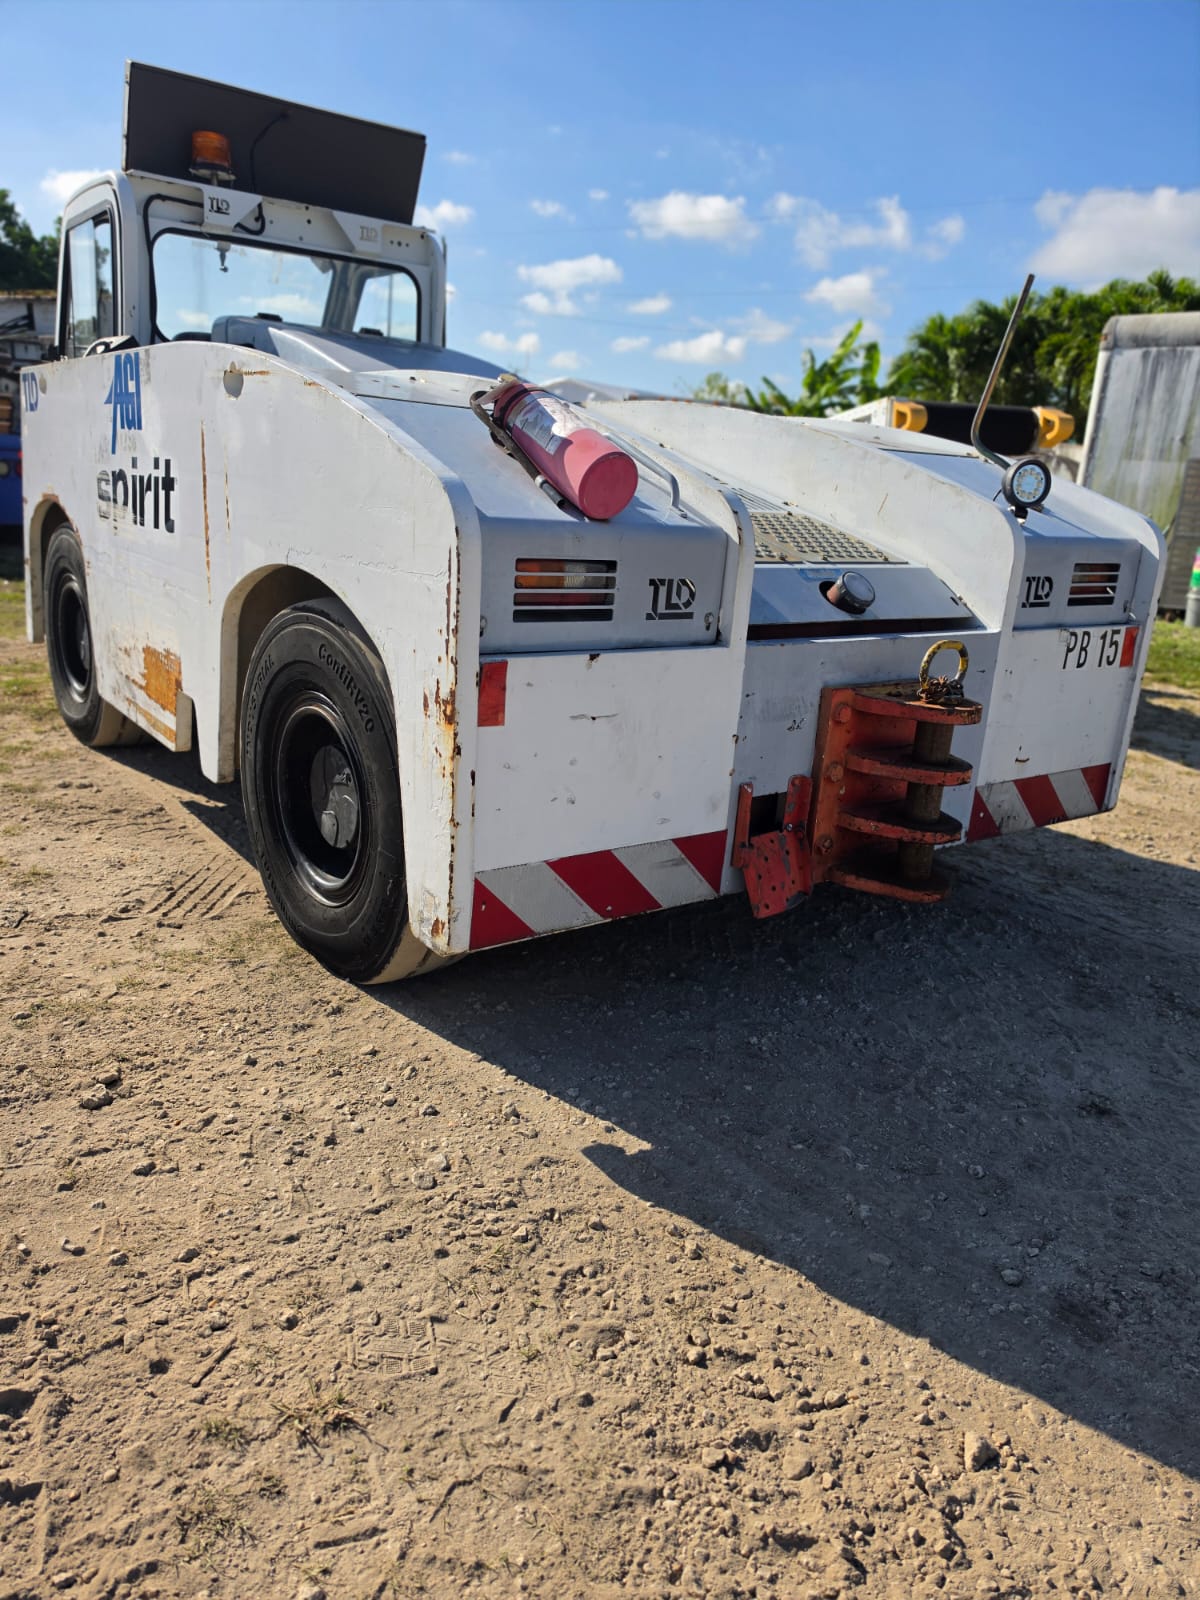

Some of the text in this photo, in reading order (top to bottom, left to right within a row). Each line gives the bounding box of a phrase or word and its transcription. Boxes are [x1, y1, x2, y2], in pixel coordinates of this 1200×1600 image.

[208, 196, 230, 216] TLD
[22, 371, 39, 413] TLD
[105, 352, 143, 454] AGI
[97, 456, 175, 536] spirit
[646, 578, 696, 621] TLD
[1021, 576, 1053, 608] TLD
[1063, 629, 1121, 669] PB 15
